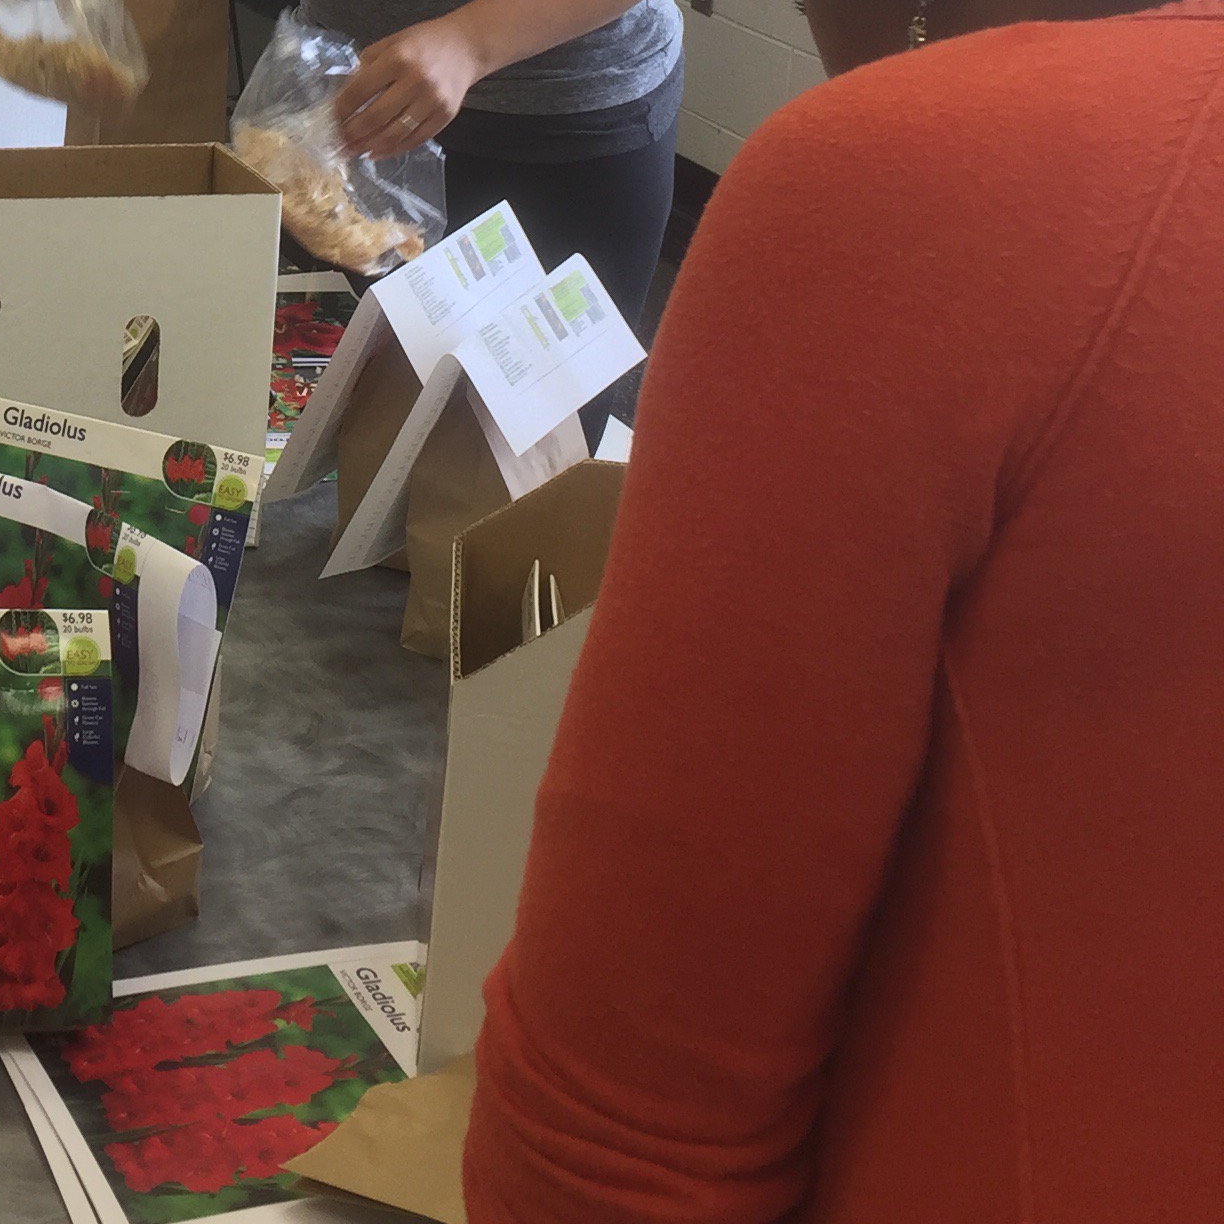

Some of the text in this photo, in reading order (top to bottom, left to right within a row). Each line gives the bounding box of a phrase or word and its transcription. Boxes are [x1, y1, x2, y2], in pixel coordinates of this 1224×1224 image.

[3, 406, 87, 441] Gladiolus
[0, 430, 52, 450] VICTOR BORGE
[223, 452, 251, 468] $6.98
[218, 484, 242, 497] EASY
[62, 612, 93, 624] $6.98
[62, 625, 93, 633] 20 bulbs
[66, 649, 94, 659] EASY
[356, 967, 411, 1033] Gladiolus
